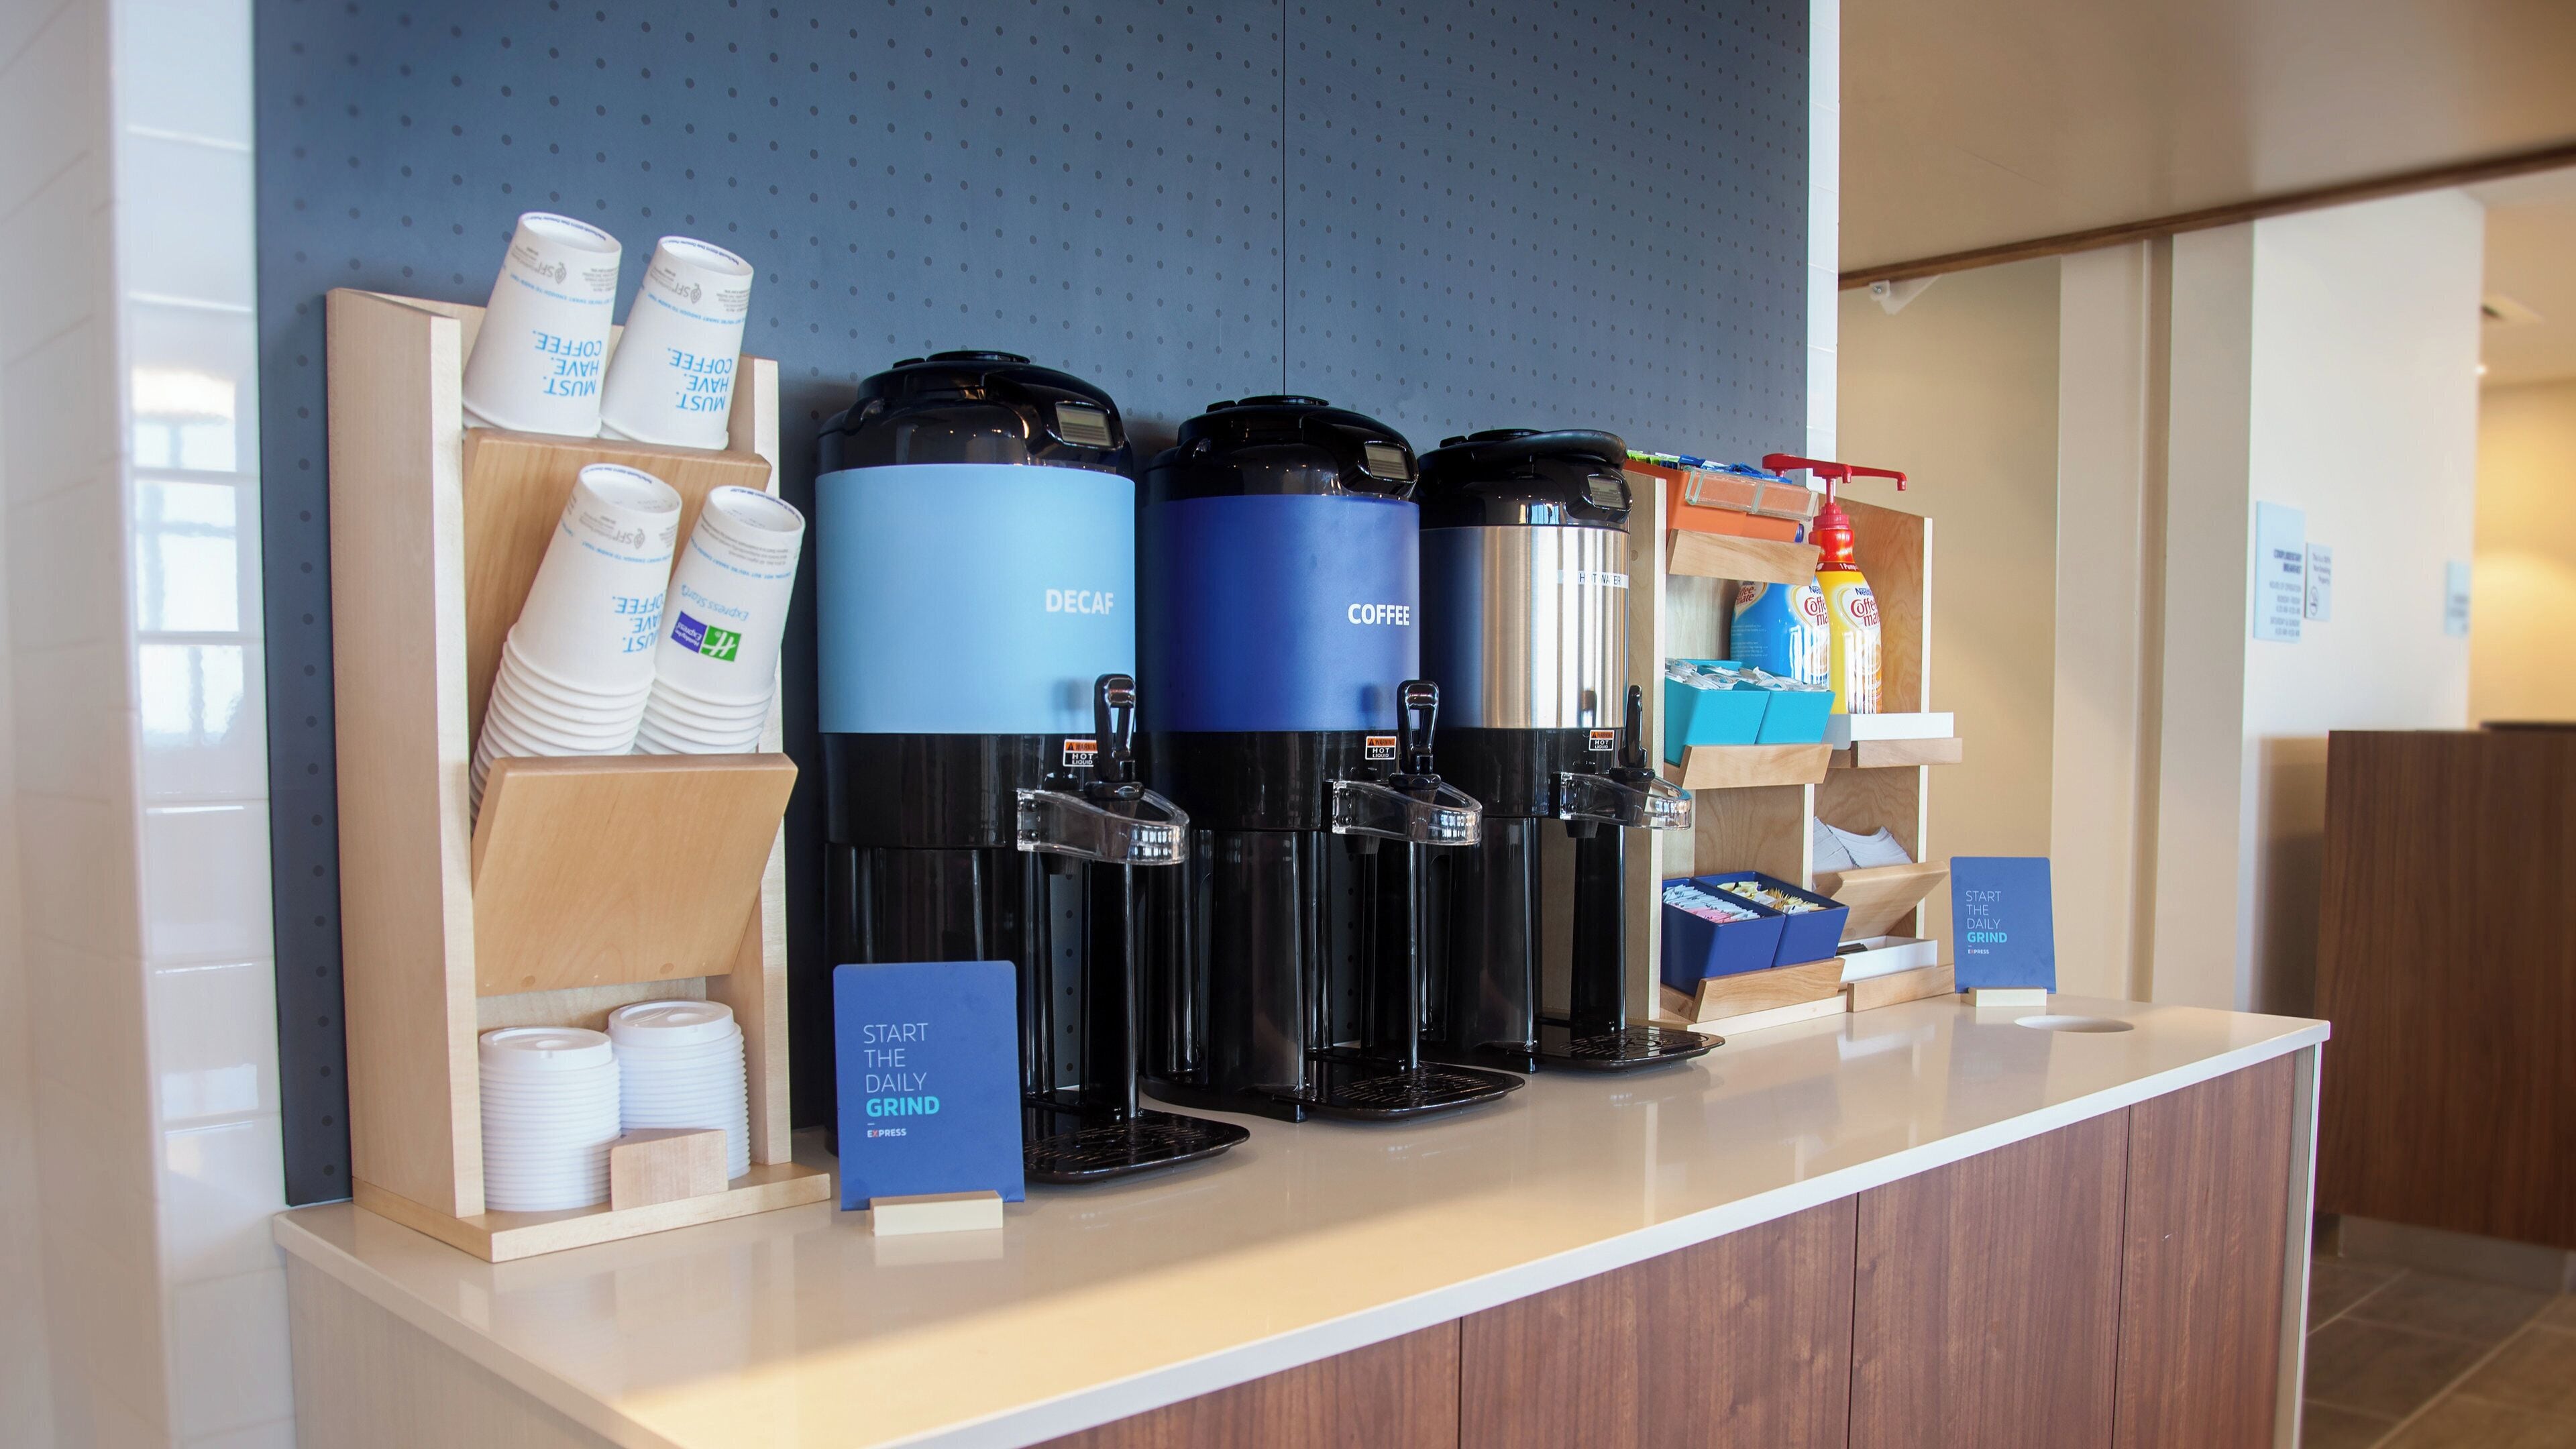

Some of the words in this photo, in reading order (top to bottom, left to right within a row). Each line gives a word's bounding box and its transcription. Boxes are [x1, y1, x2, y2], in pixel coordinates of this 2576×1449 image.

[675, 282, 691, 298] SFI
[533, 329, 602, 357] COFFEE.
[551, 357, 600, 377] HAVE.
[667, 347, 733, 374] COFFEE.
[543, 376, 596, 397] MUST.
[684, 373, 729, 393] HAVE.
[676, 391, 726, 412] MUST.
[1579, 572, 1597, 584] HT
[1601, 574, 1621, 585] WAER
[611, 592, 663, 615] OFFEE.
[1046, 589, 1114, 615] DECAF
[1804, 596, 1827, 616] Coff
[629, 610, 661, 634] AVE.
[1348, 603, 1410, 626] COFFEE
[1816, 612, 1829, 627] ma
[1863, 612, 1880, 627] ma
[1075, 742, 1097, 751] WARNIN
[1966, 890, 2002, 902] START
[1966, 904, 1989, 916] THE
[1967, 918, 2000, 930] DAILY
[1967, 932, 2007, 943] GRIND
[863, 1023, 928, 1044] START
[864, 1049, 906, 1068] THE
[866, 1072, 927, 1093] DAILY
[866, 1095, 940, 1117] GRIND
[867, 1128, 907, 1138] EXPRESS
